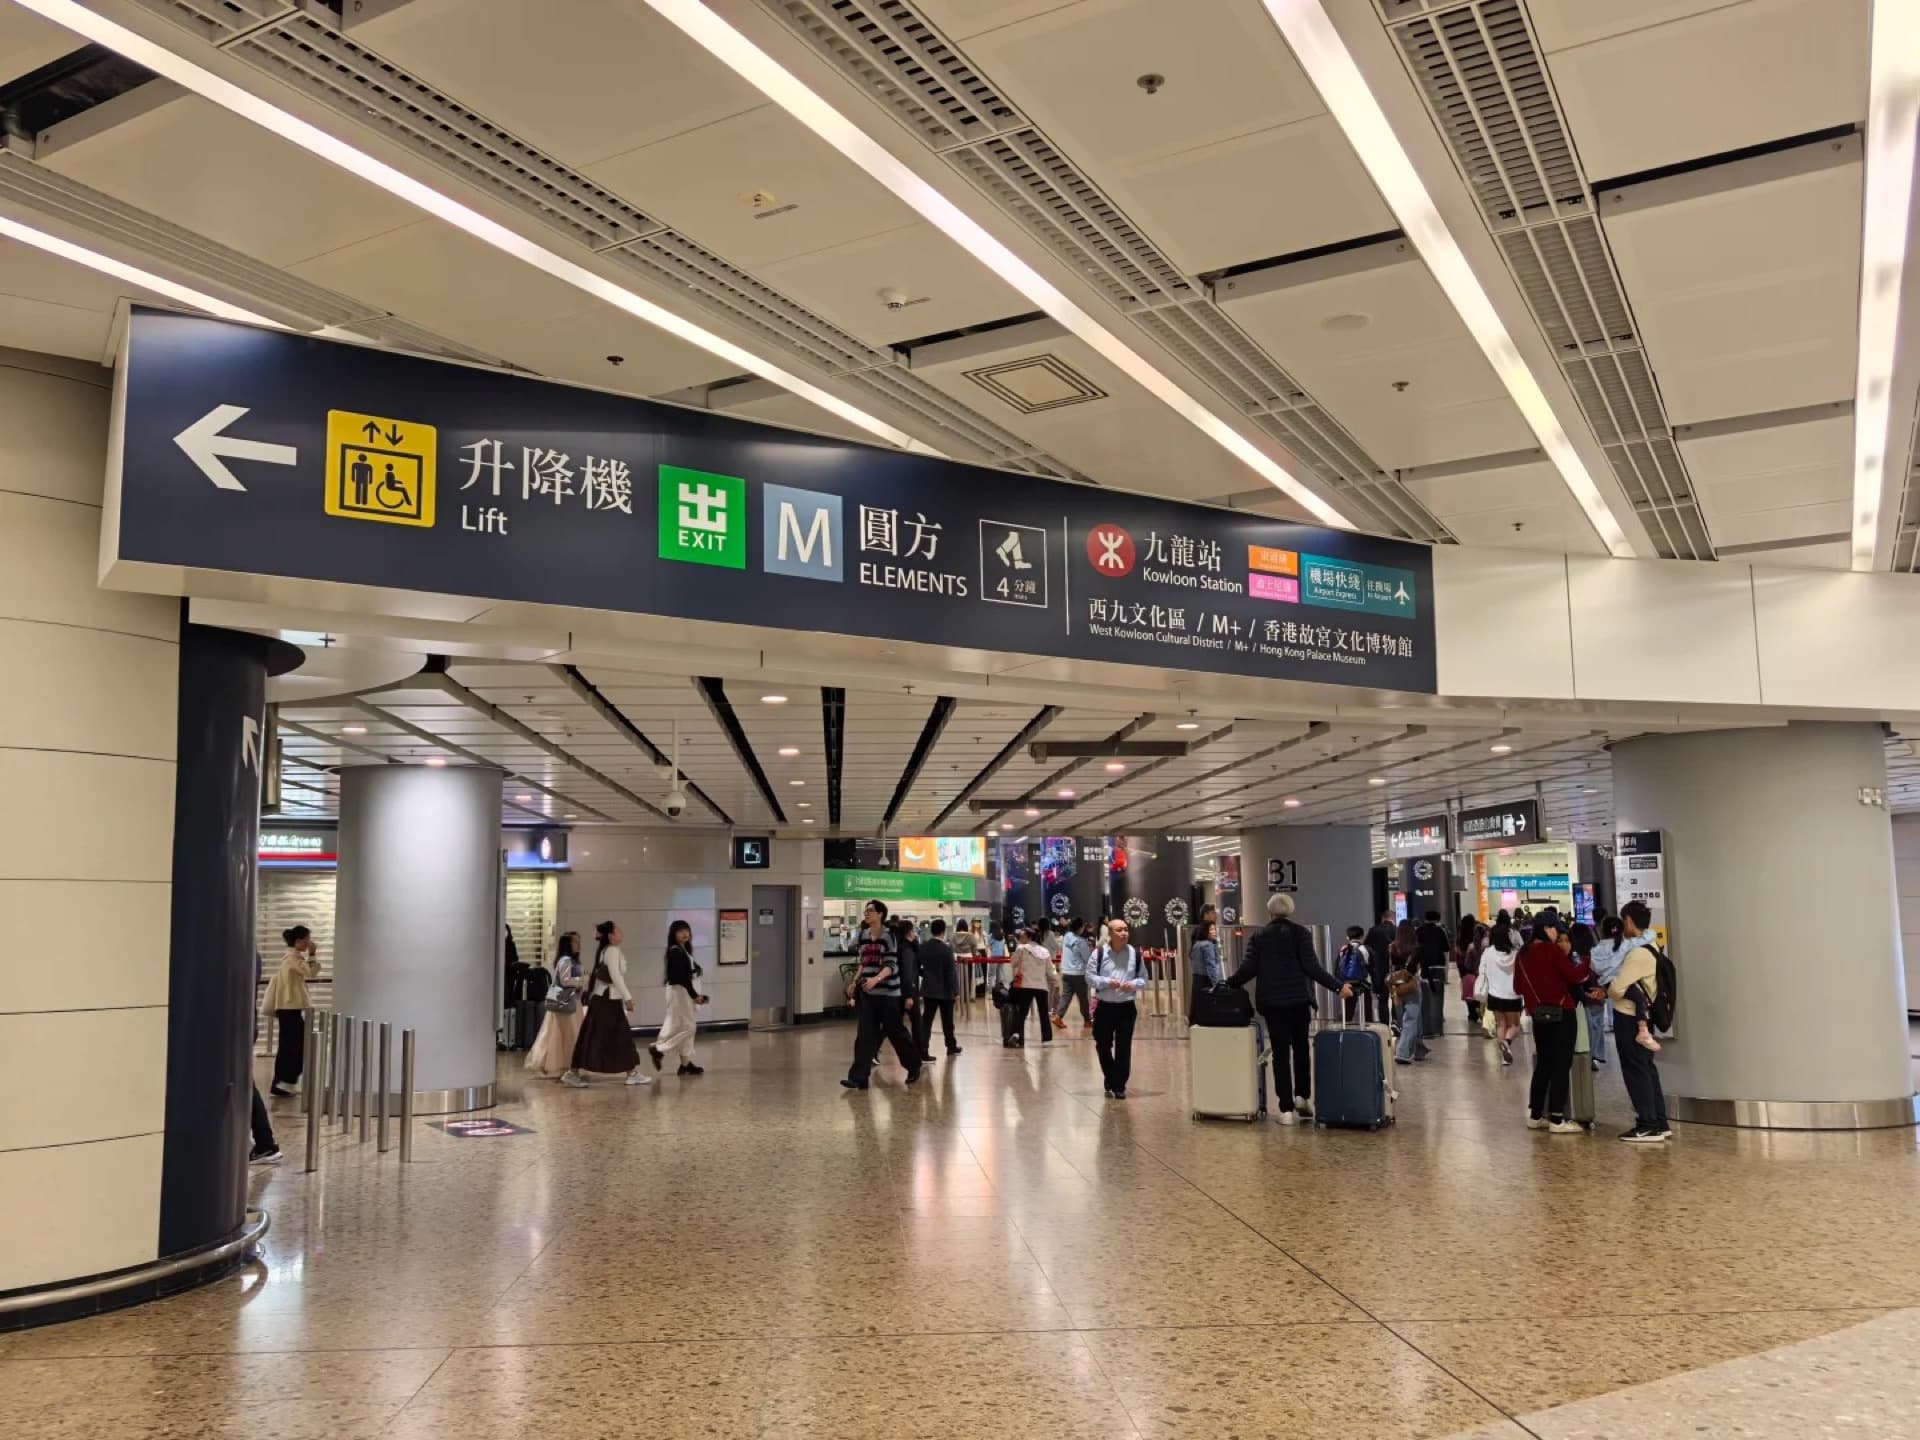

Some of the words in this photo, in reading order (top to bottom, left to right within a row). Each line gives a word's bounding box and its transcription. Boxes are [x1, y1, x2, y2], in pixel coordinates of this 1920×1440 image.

[458, 438, 634, 515] 升降機
[462, 505, 508, 536] Lift
[678, 530, 728, 552] EXIT
[778, 502, 832, 567] M
[859, 504, 943, 561] 圓方
[1144, 531, 1221, 572] 九龍站
[859, 562, 968, 597] ELEMENTS
[997, 577, 1010, 597] 4
[1143, 567, 1197, 588] Kowloon
[1200, 575, 1243, 593] Station
[1089, 598, 1186, 630] 西九文化區
[1197, 612, 1204, 632] /
[1213, 614, 1241, 636] M+
[1249, 618, 1256, 639] /
[1264, 620, 1413, 658] 香港故宮文化博物館
[1089, 623, 1112, 637] West
[1114, 626, 1154, 641] Kowloon
[1155, 631, 1190, 645] Cultural
[1193, 635, 1223, 649] District
[1234, 640, 1249, 651] M+
[1260, 644, 1282, 658] Hong
[1284, 645, 1305, 661] Kong
[1307, 650, 1331, 662] Palace
[1333, 653, 1366, 665] Museum
